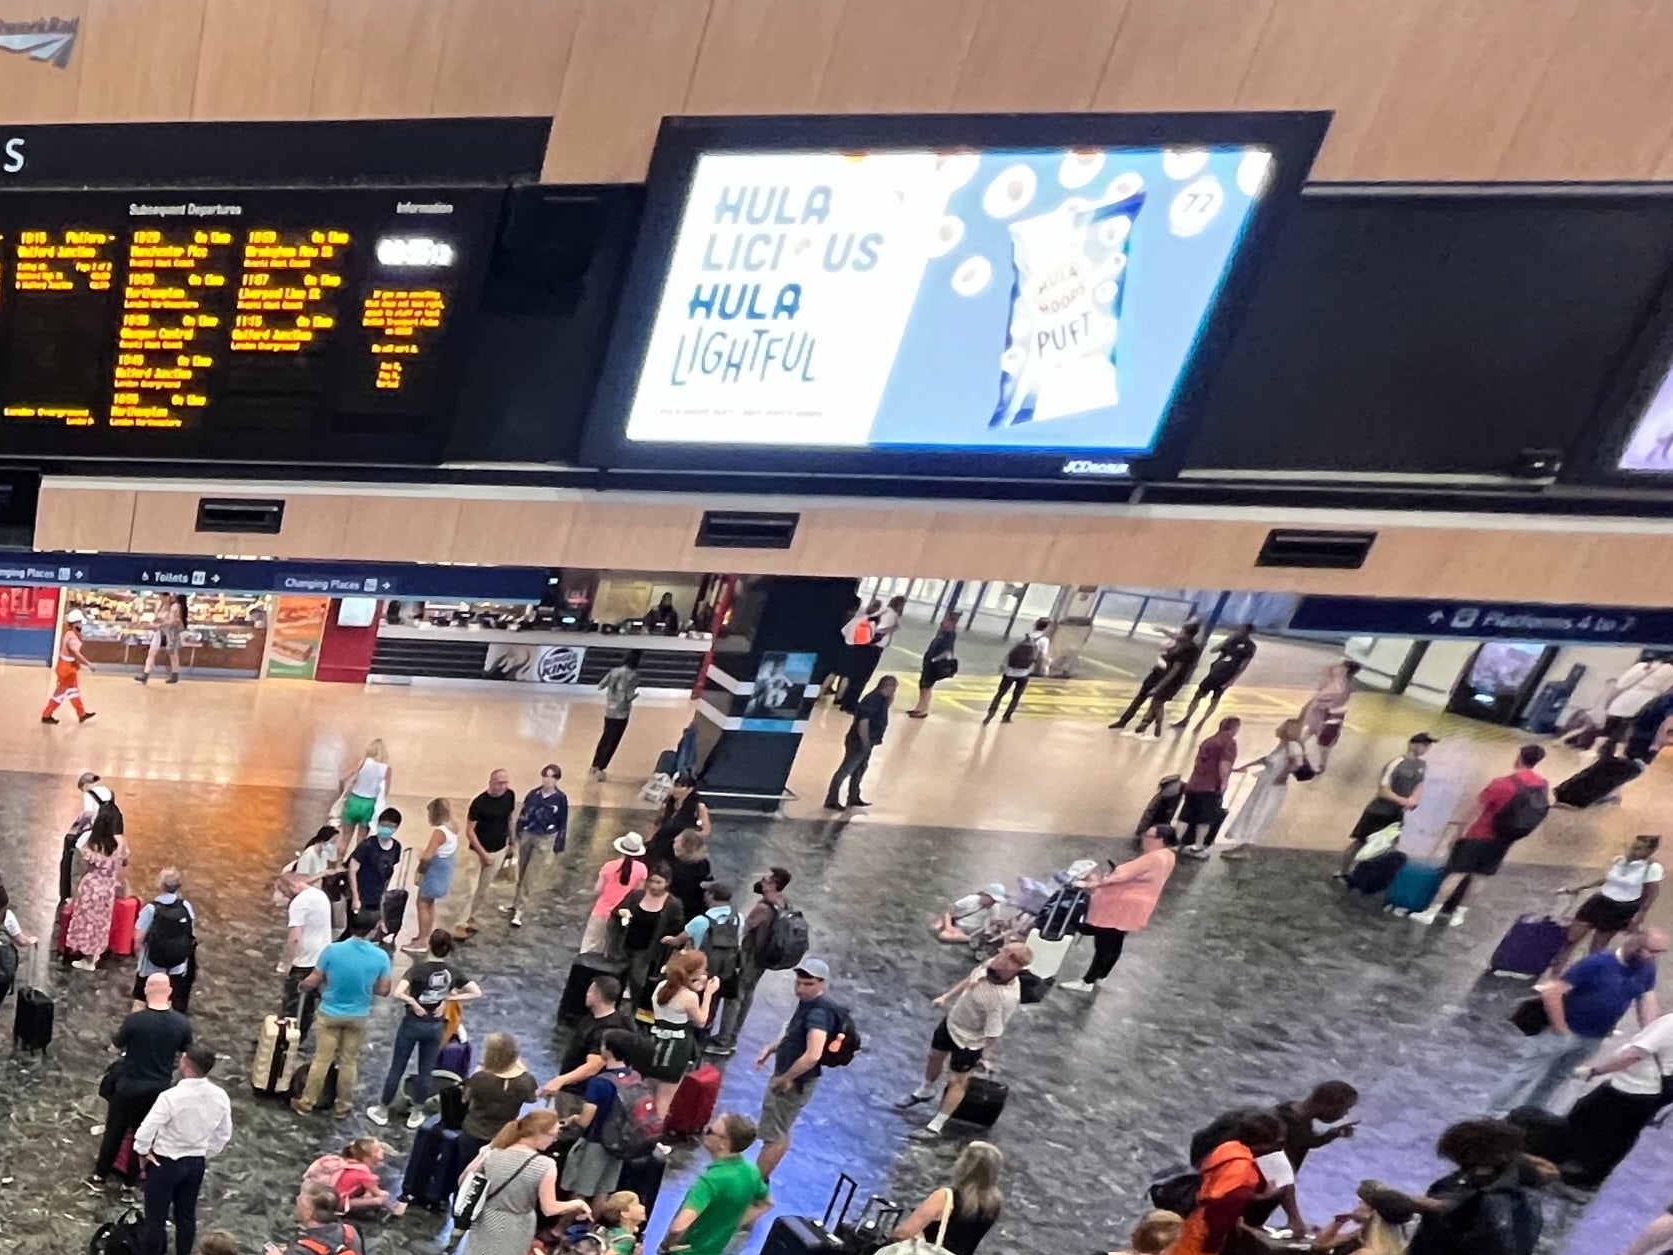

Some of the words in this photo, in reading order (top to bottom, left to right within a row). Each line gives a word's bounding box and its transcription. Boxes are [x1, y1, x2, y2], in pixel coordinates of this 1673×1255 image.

[714, 185, 833, 225] HULA
[688, 283, 802, 321] HULA
[1037, 311, 1092, 358] PUFT
[670, 327, 815, 386] LIGHTFUL
[26, 567, 55, 579] Places
[154, 571, 189, 583] Toilets
[284, 577, 330, 591] Changing
[330, 579, 360, 591] Places
[1482, 609, 1574, 631] Platforms
[1576, 615, 1593, 630] 4
[1593, 616, 1617, 632] to
[542, 662, 577, 677] KING
